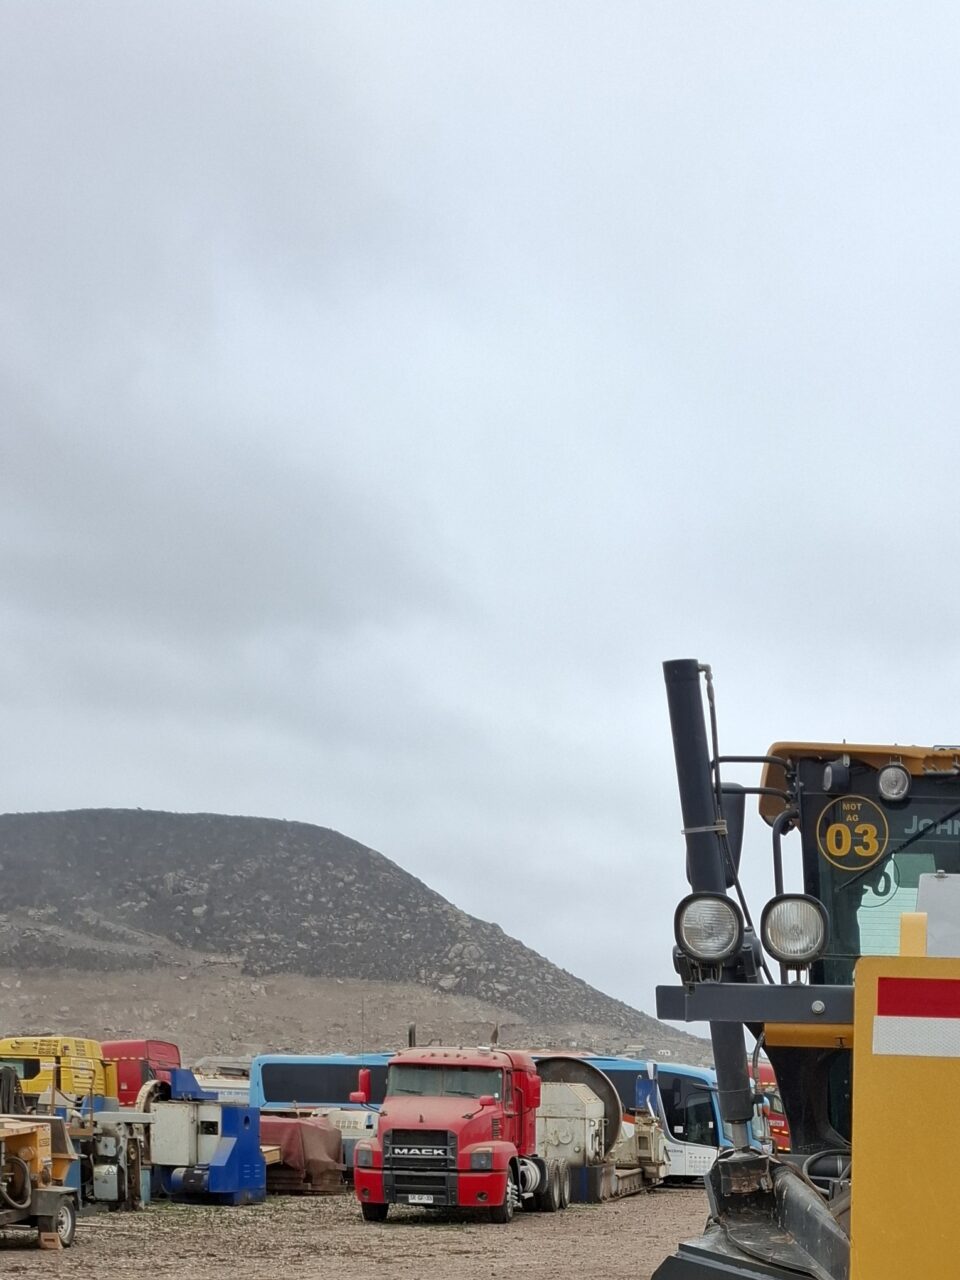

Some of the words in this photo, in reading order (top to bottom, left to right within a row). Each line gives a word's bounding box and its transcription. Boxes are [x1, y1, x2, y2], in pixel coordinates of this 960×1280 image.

[842, 803, 862, 811] MOT
[826, 823, 879, 857] 03
[394, 1148, 445, 1156] MACK
